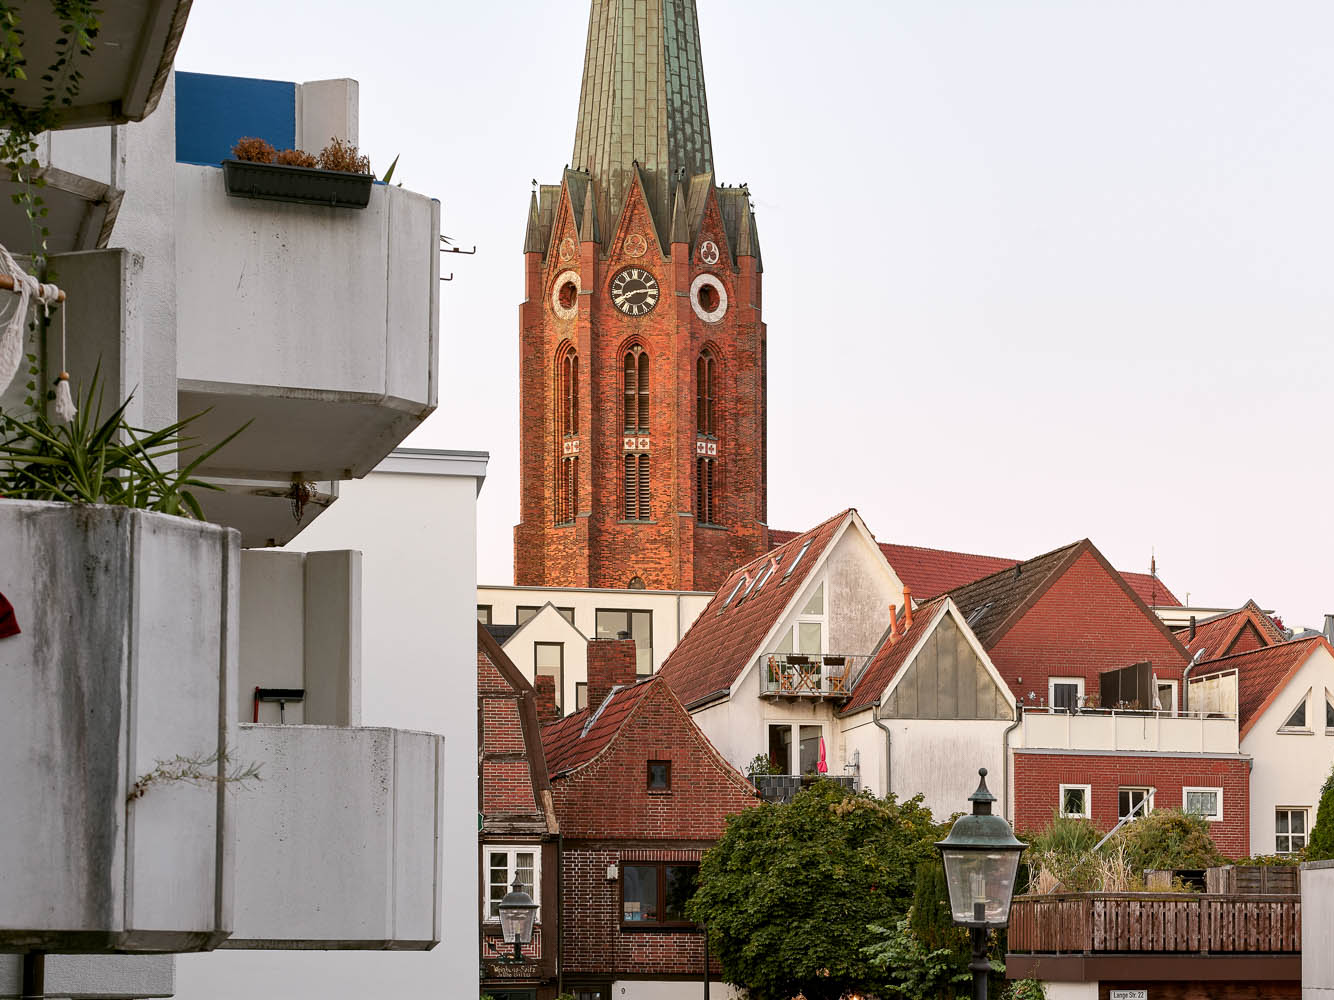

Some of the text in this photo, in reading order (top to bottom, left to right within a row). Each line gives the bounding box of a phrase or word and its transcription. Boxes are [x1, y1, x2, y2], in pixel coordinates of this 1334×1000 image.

[1113, 991, 1144, 1000] Lange Str. 22
